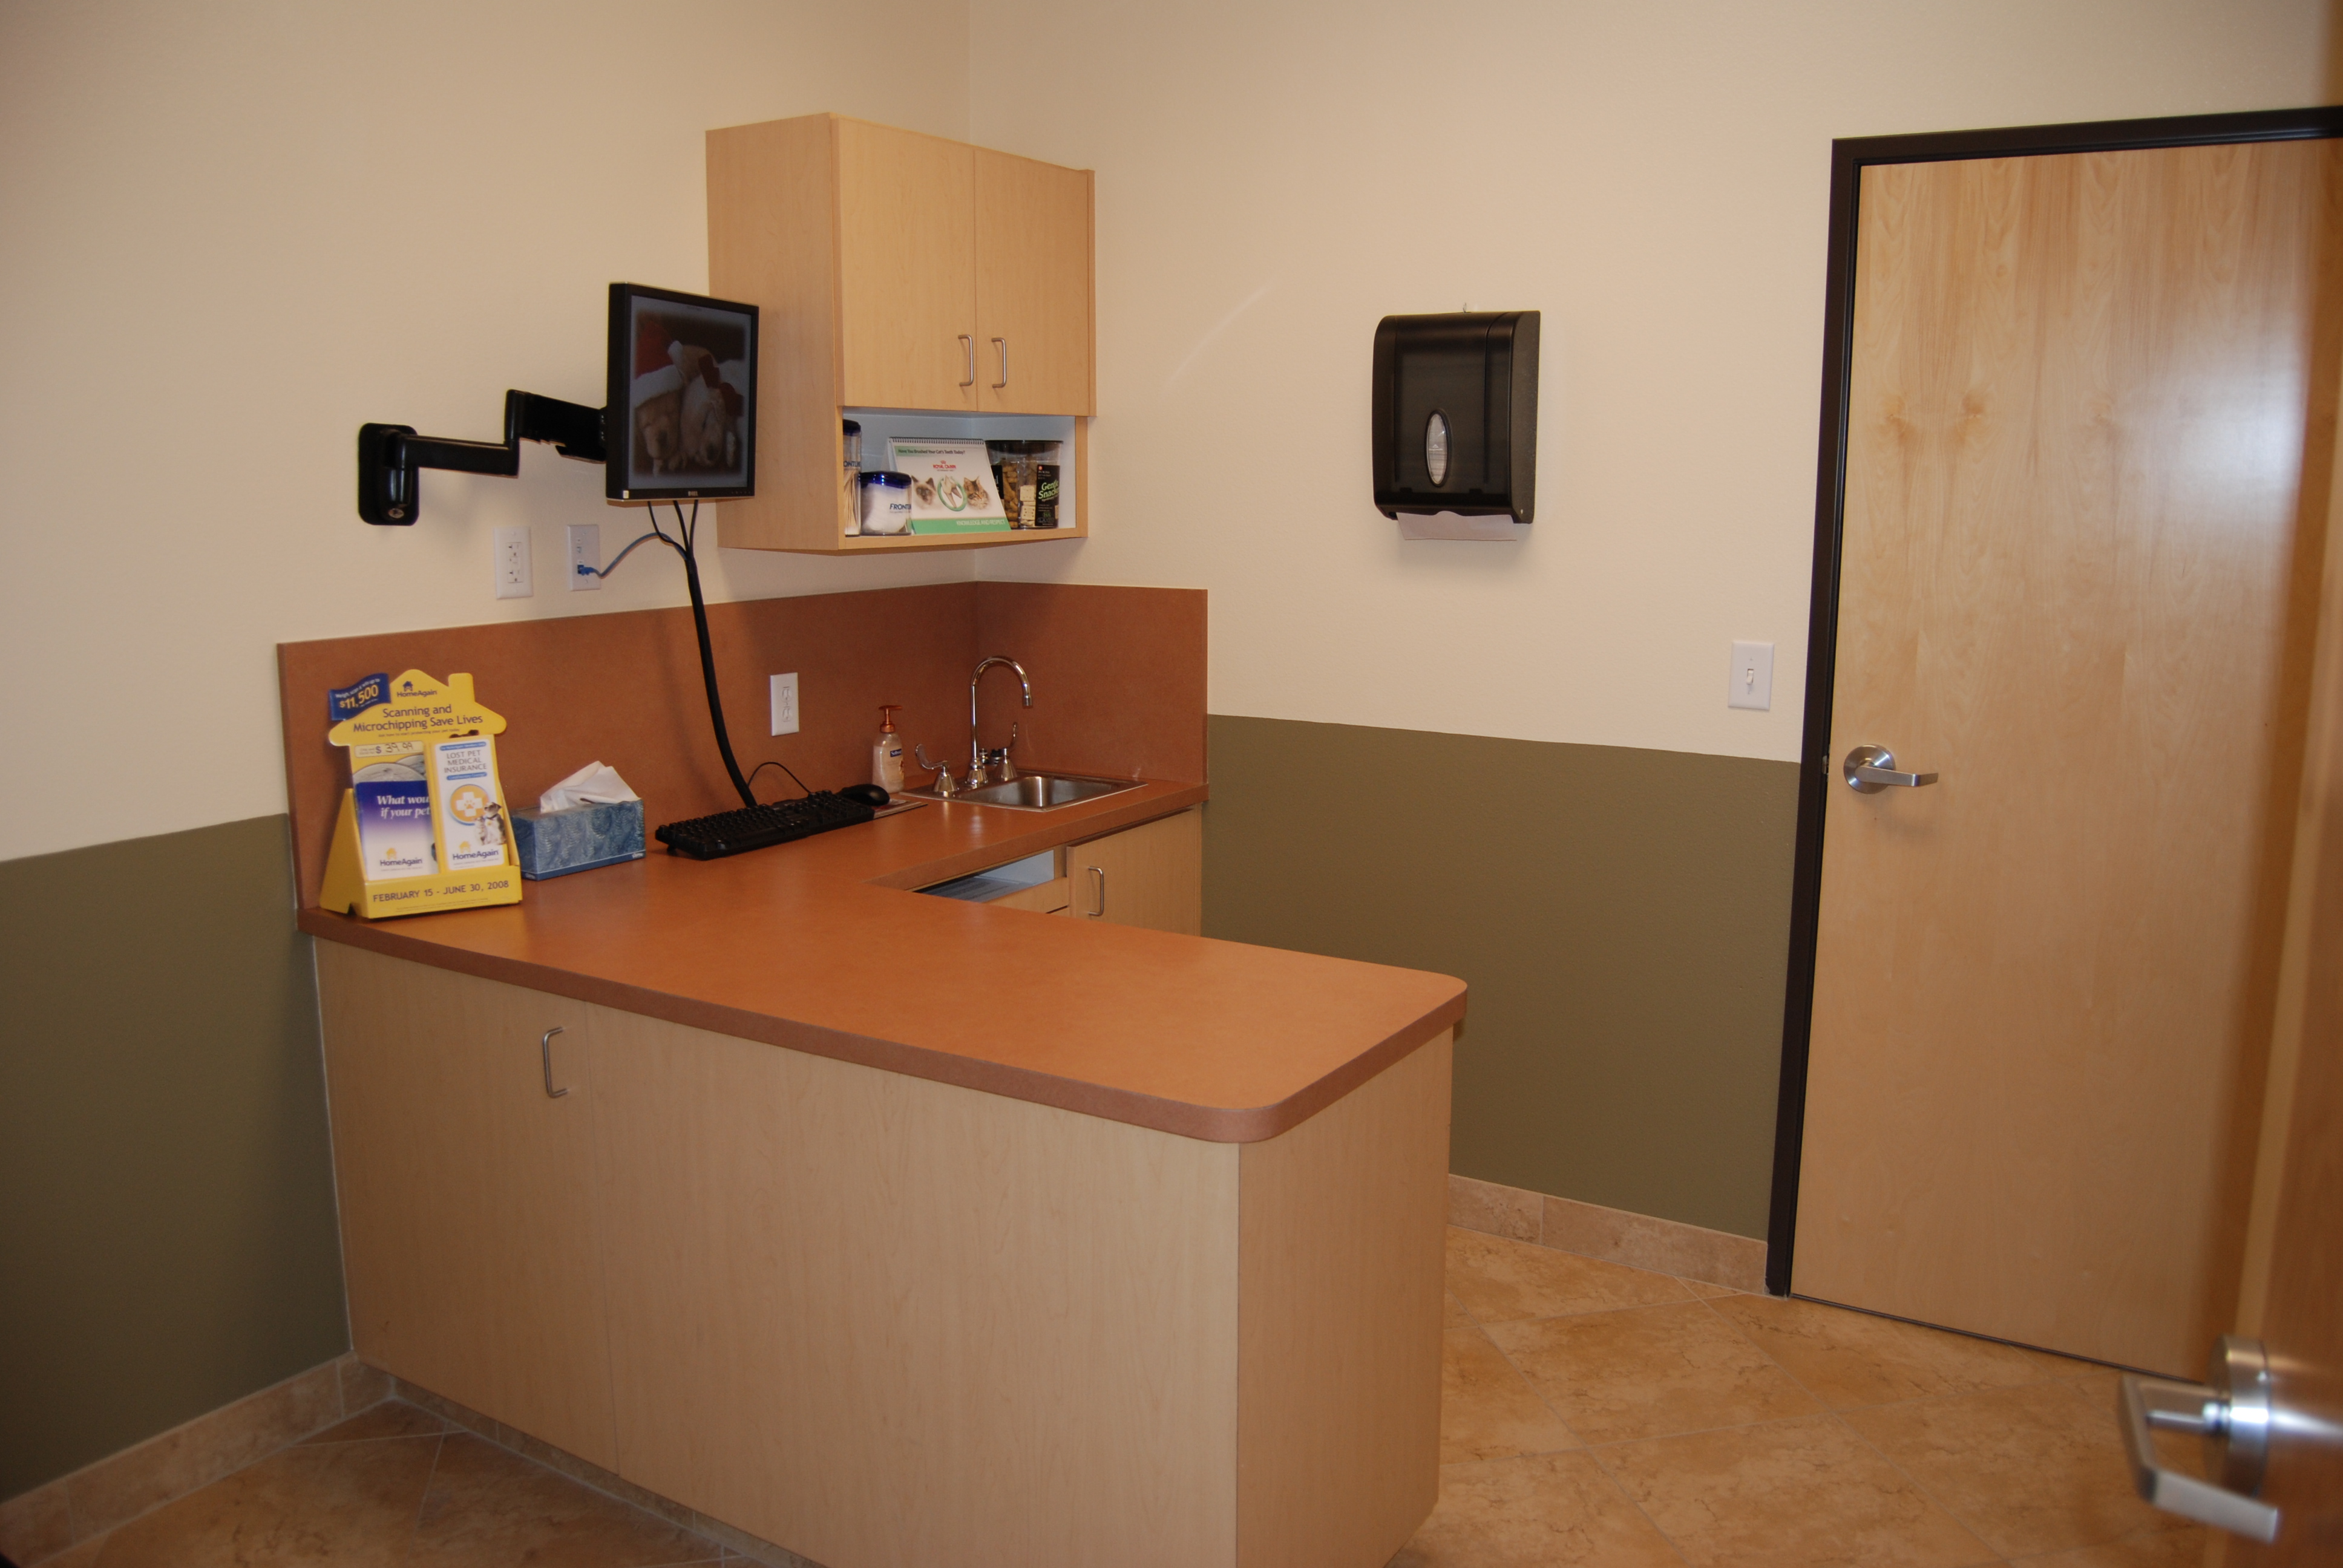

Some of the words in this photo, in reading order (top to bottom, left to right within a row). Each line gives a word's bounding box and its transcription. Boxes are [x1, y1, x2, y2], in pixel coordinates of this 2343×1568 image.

[339, 685, 379, 708] $11,500
[383, 706, 430, 718] Scanning
[433, 705, 451, 714] and
[353, 718, 427, 732] Microchipping
[430, 717, 454, 727] Save
[457, 715, 483, 725] Lives
[375, 745, 382, 754] $
[448, 757, 482, 766] MEDICAL
[444, 763, 487, 773] INSURANCE
[377, 795, 406, 805] What
[381, 807, 390, 820] if
[390, 808, 413, 820] your
[415, 806, 430, 819] pet
[453, 849, 499, 860] HomeAgain
[379, 857, 422, 866] HomeAgain
[373, 890, 420, 902] FEBRUARY
[424, 888, 433, 897] 15
[443, 885, 466, 895] JUNE
[470, 883, 483, 892] 30,
[487, 880, 509, 890] 2008
